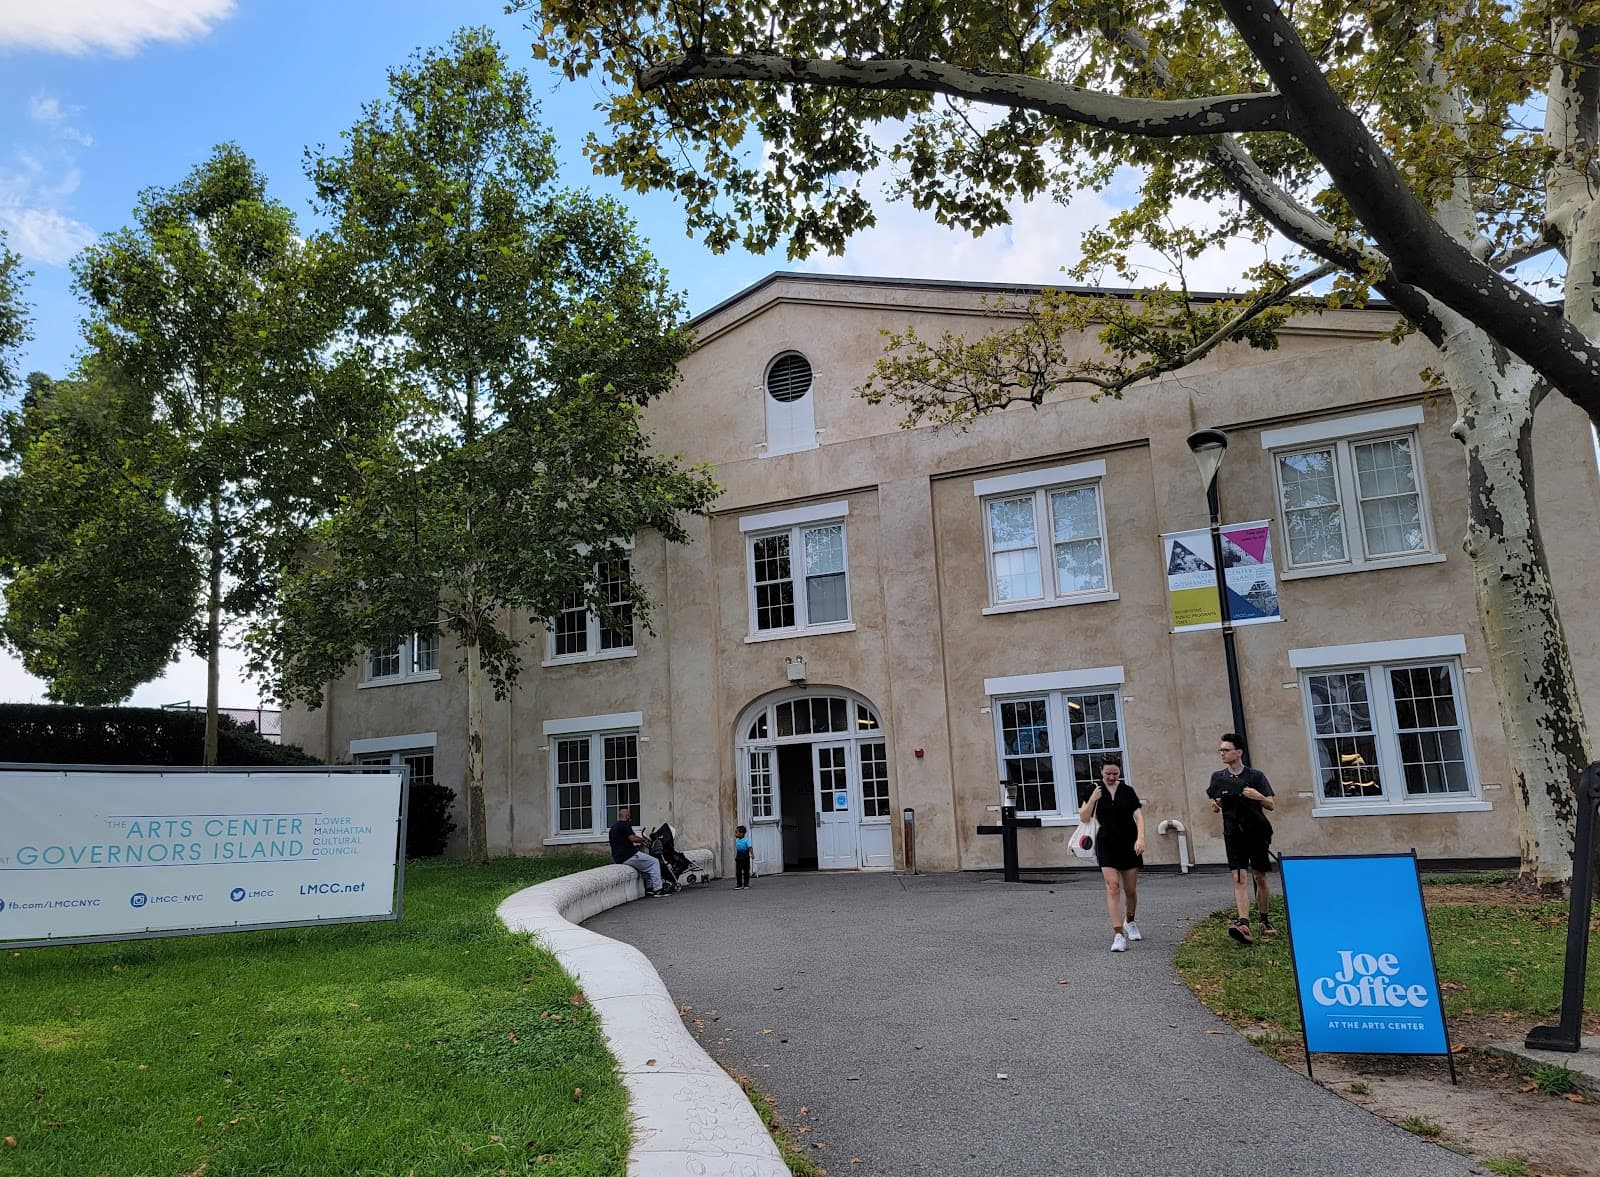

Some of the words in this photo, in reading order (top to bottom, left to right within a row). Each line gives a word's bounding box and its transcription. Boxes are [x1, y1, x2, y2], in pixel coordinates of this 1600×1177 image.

[314, 816, 352, 826] LOWER
[107, 820, 127, 829] THE
[126, 820, 193, 839] ARTS
[204, 818, 303, 838] CENTER
[313, 826, 372, 836] MANHATTAN
[312, 836, 361, 846] CULTURAL
[0, 856, 9, 865] AT
[16, 842, 202, 865] GOVERNORS
[213, 840, 303, 860] ISLAND
[311, 846, 358, 857] COUNCIL
[299, 881, 366, 895] LMCC.net
[150, 893, 204, 904] LMCC_NYC
[248, 890, 275, 898] LMCC
[8, 898, 101, 910] fb.com/LMCCNYC
[1335, 950, 1400, 982] Joe
[1312, 975, 1430, 1008] Coffee
[1328, 1020, 1340, 1029] AT
[1340, 1021, 1360, 1030] THE
[1361, 1021, 1386, 1030] ARTS
[1387, 1022, 1425, 1031] CENTER
